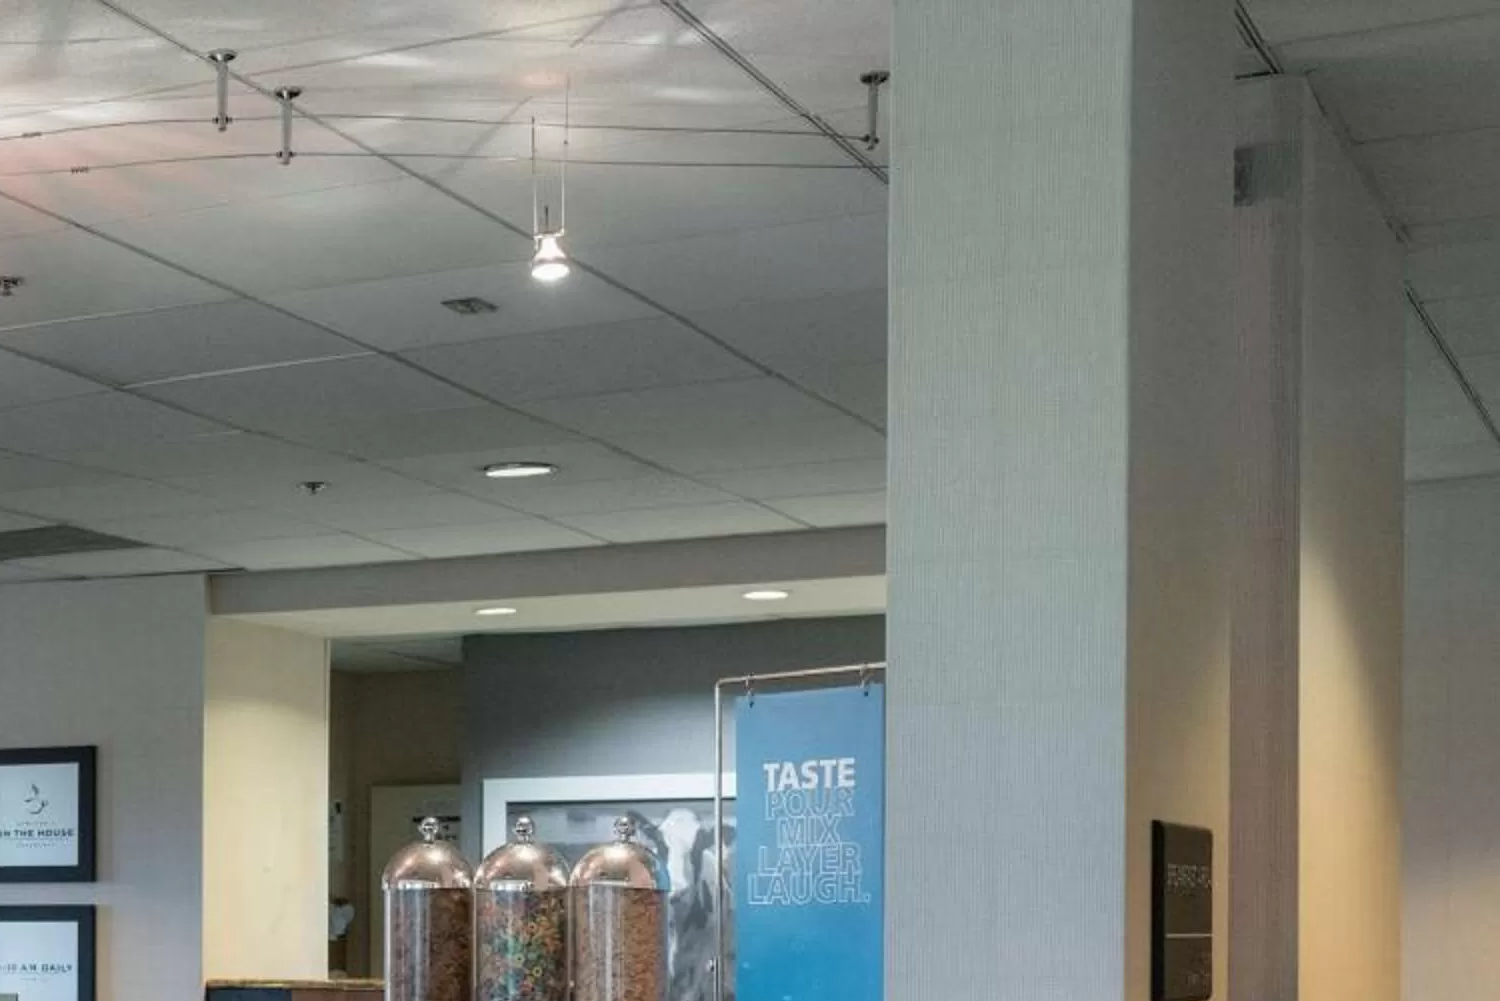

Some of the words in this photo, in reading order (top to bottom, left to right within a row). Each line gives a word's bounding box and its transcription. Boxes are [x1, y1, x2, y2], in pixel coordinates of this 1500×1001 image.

[763, 757, 856, 792] TASTE
[764, 787, 856, 821] POUR
[13, 829, 35, 837] THE
[37, 828, 75, 837] HOUSE
[777, 815, 842, 848] MIX
[758, 842, 863, 876] LAYER
[747, 871, 872, 905] LAUGH.
